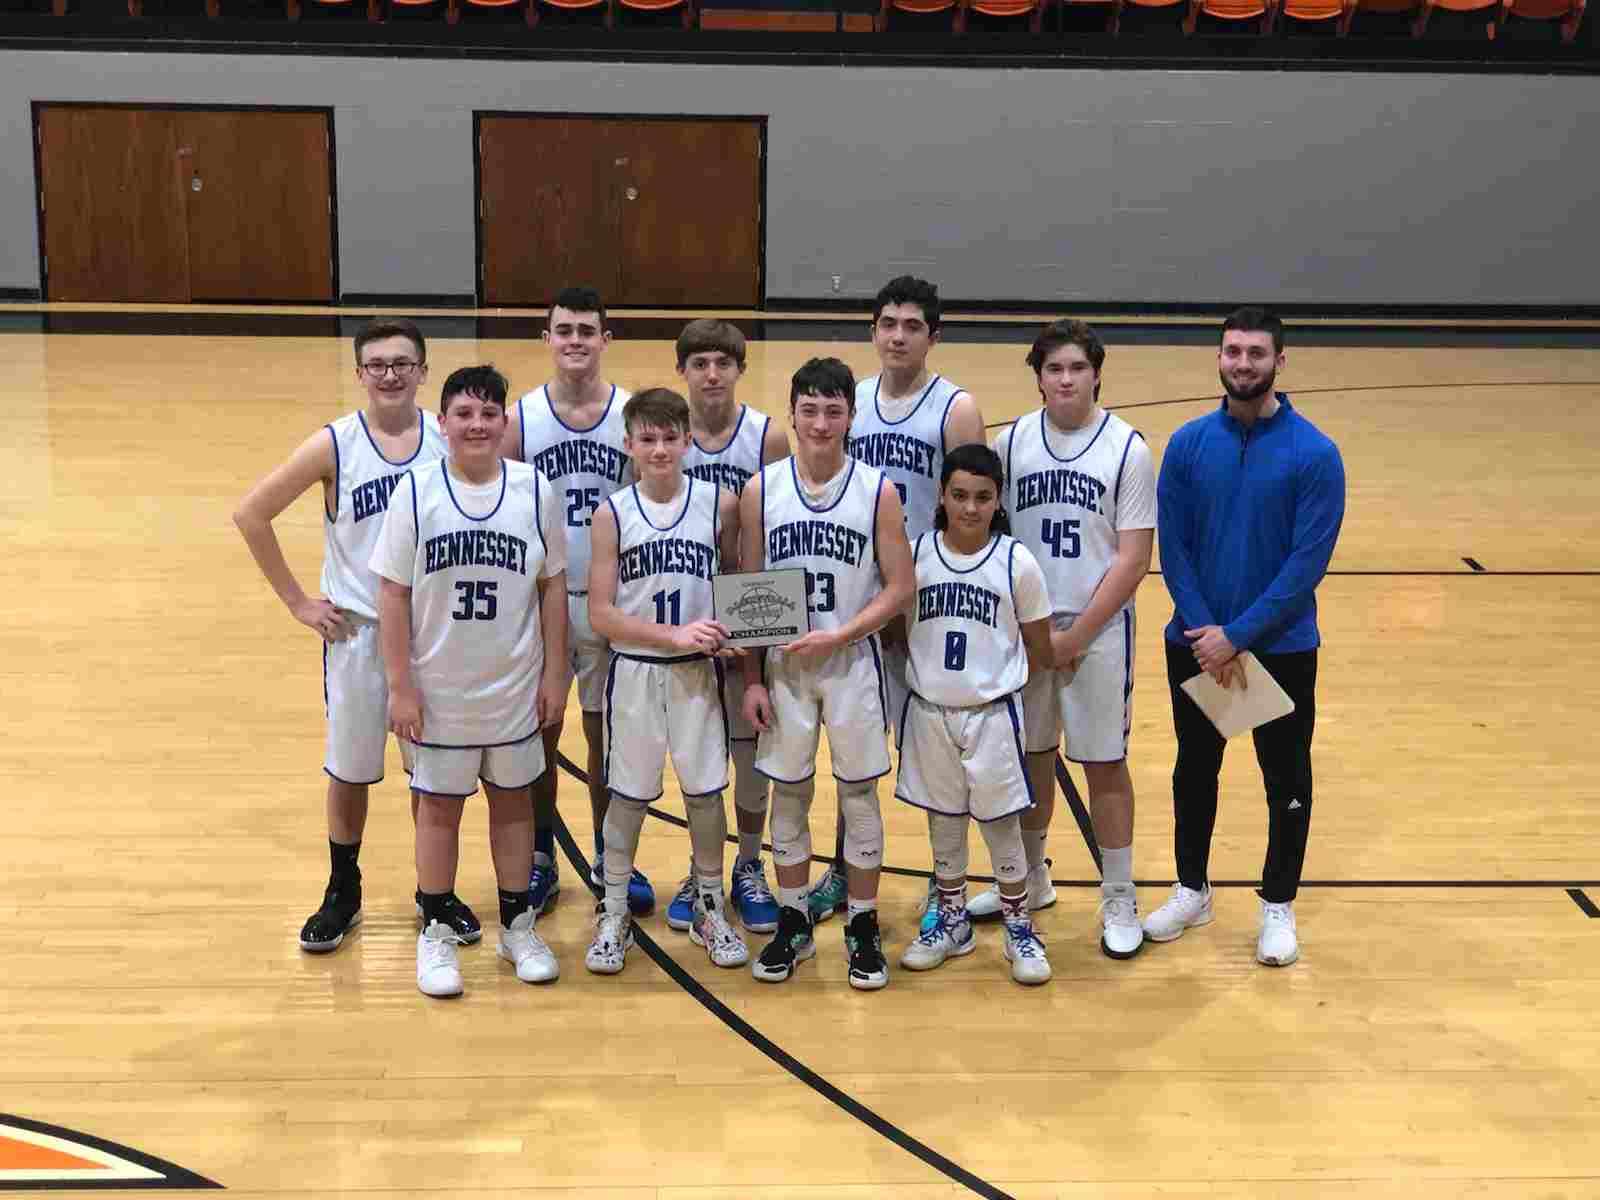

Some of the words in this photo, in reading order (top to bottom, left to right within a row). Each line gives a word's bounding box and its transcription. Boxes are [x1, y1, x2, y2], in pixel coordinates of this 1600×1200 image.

[565, 487, 601, 527] 25
[424, 529, 528, 577] HENNESSEY
[769, 520, 867, 569] HENNESSEY
[1040, 518, 1081, 558] 45
[619, 537, 715, 585] HENNESSEY
[451, 580, 498, 620] 35
[652, 588, 681, 626] 11
[918, 582, 1001, 629] HENNESSEY
[733, 628, 791, 638] CHAMPION
